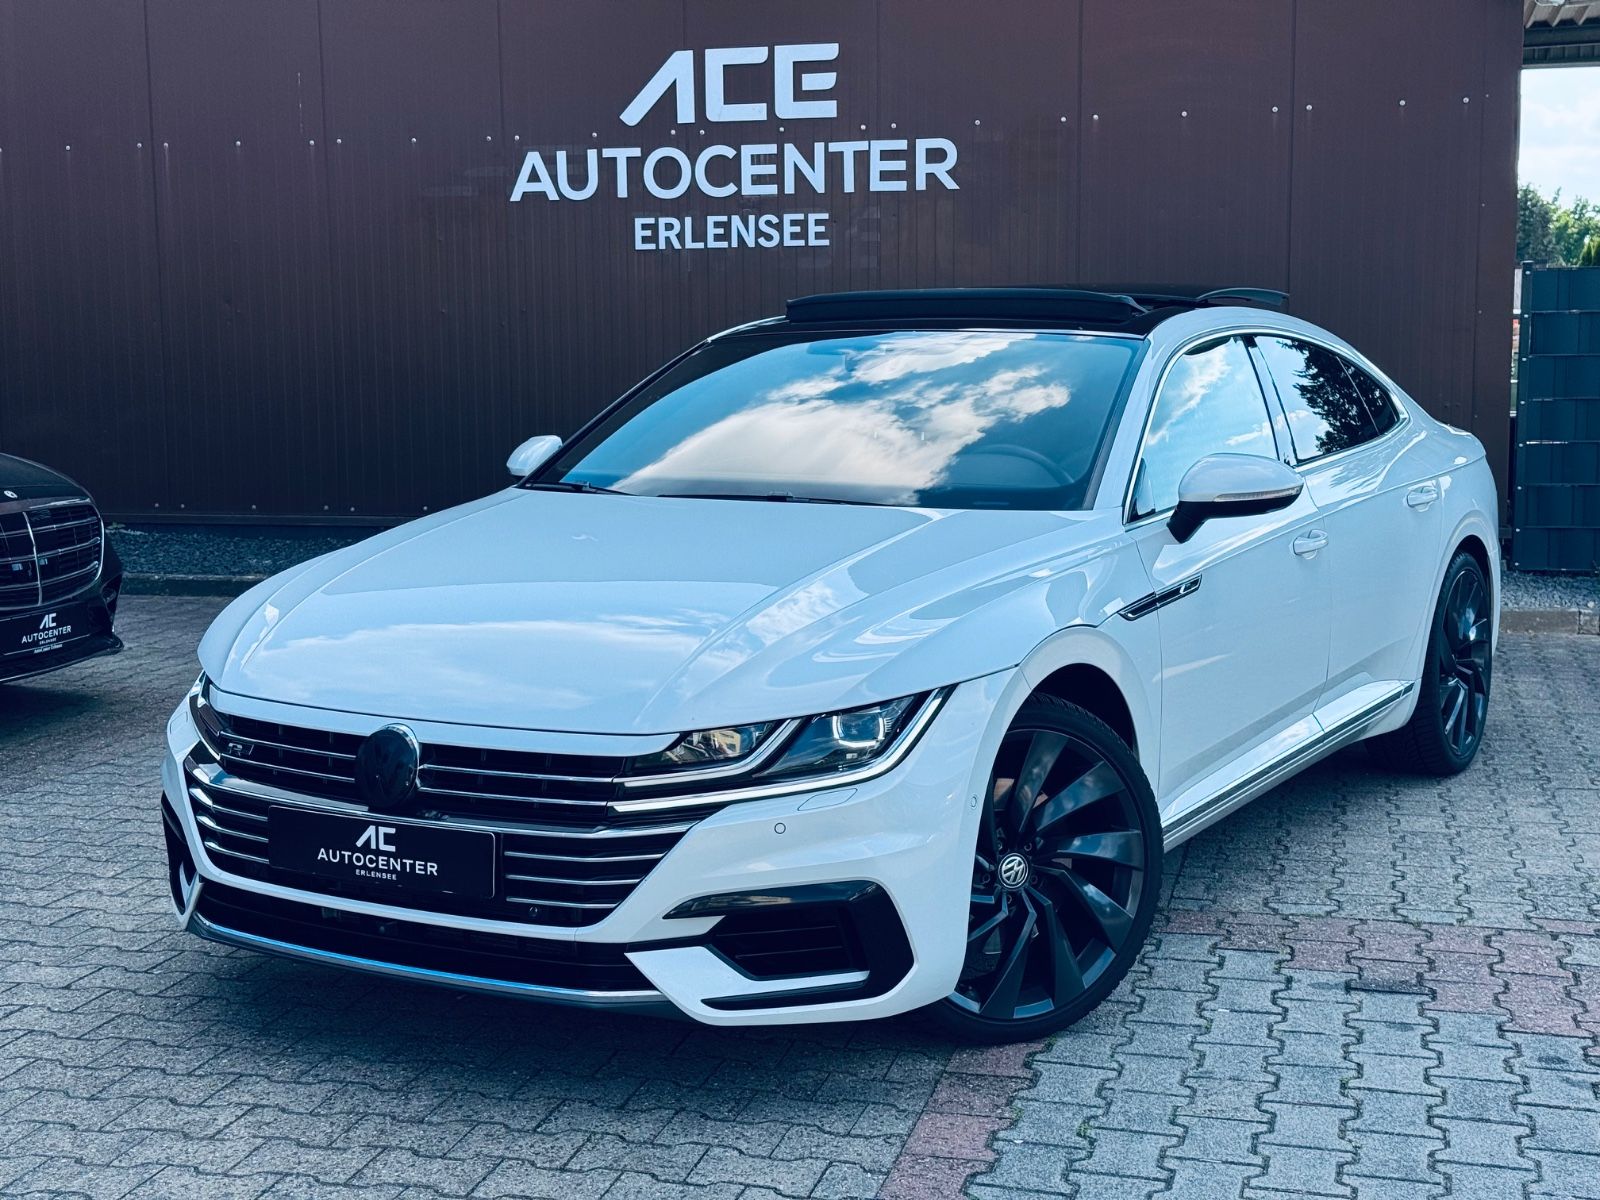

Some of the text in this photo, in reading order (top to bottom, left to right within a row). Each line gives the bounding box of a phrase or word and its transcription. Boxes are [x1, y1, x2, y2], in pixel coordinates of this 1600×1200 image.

[619, 43, 840, 127] ACE
[509, 138, 960, 202] AUTOCENTER
[634, 212, 830, 250] ERLENSEE
[21, 625, 71, 644] AUTOCENTER
[39, 612, 56, 629] AC
[355, 825, 396, 852] AC
[317, 847, 438, 876] AUTOCENTER
[355, 868, 397, 881] ERLENSEE
